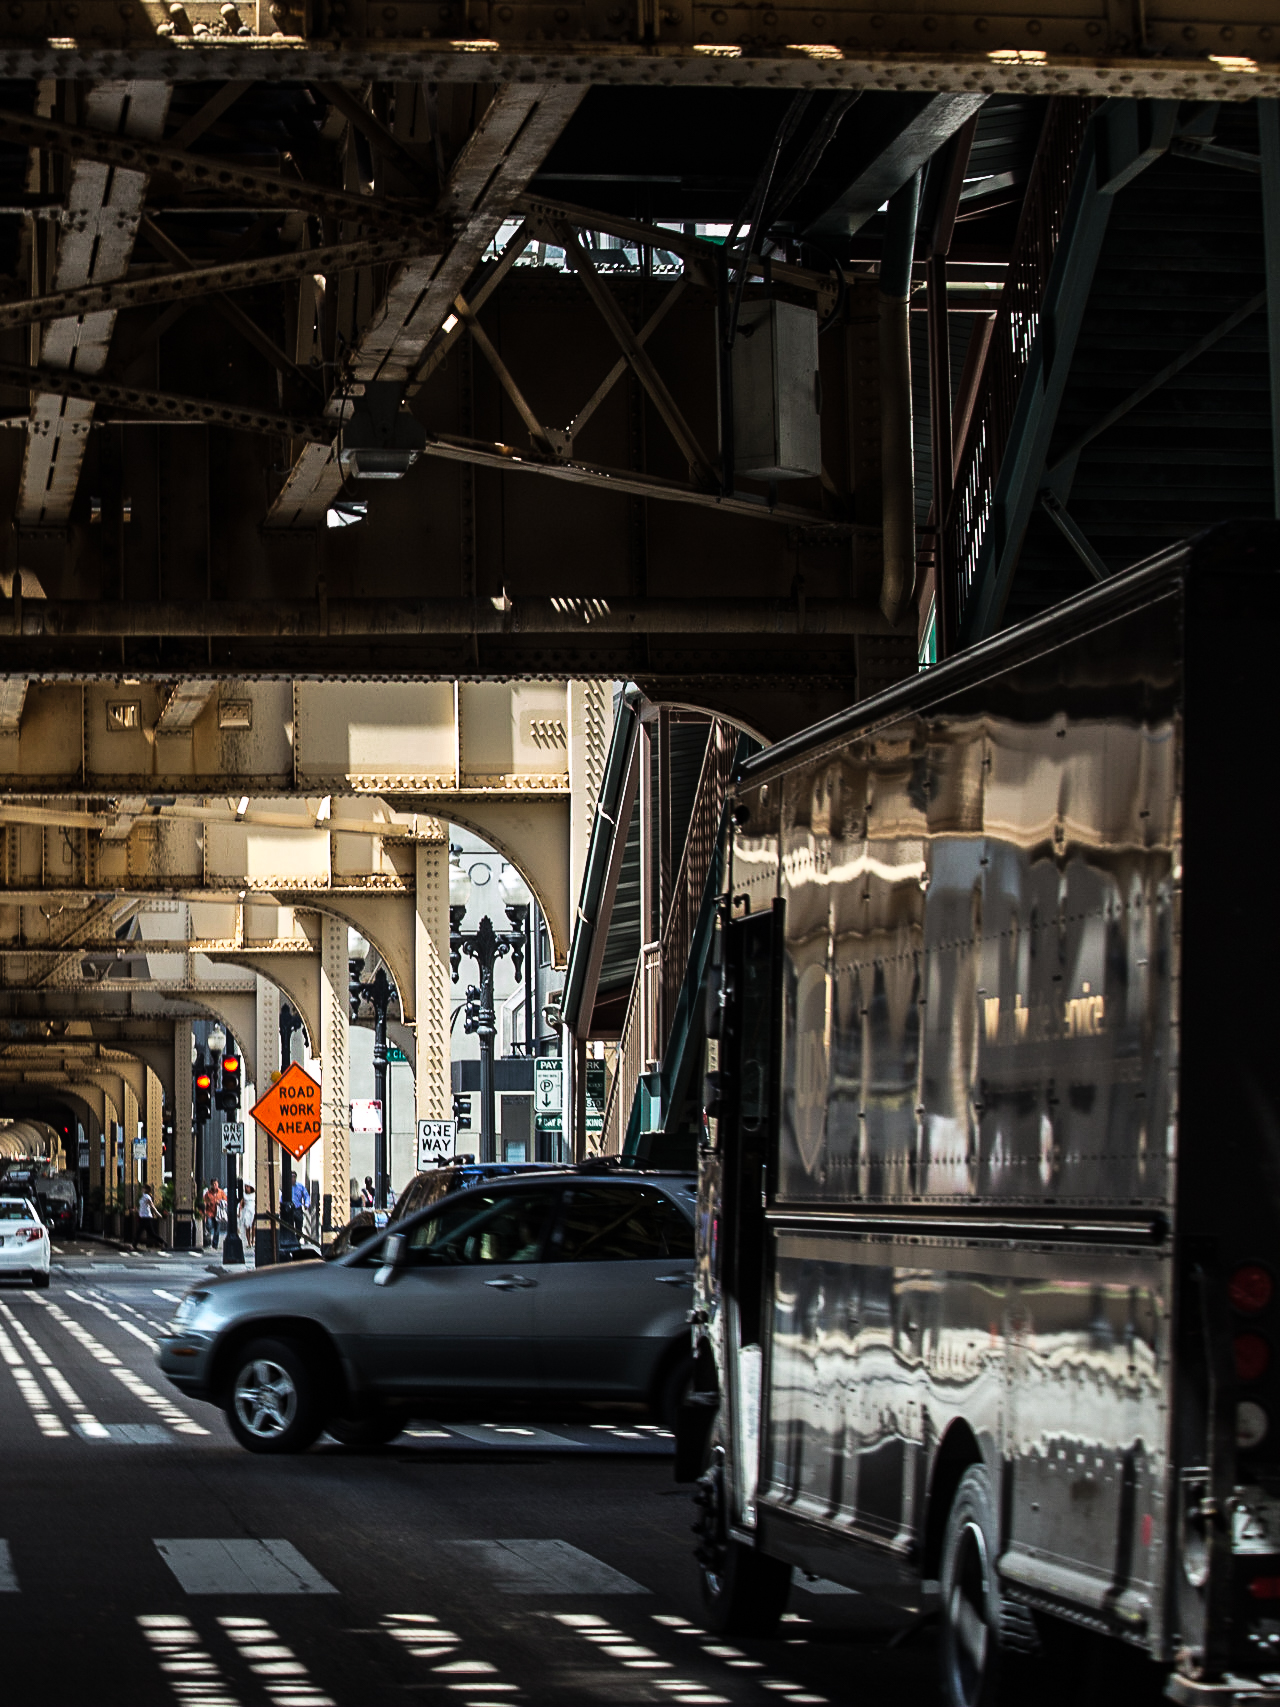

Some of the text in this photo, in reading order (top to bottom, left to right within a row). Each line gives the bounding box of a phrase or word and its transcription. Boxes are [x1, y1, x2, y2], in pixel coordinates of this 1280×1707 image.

[540, 1061, 558, 1069] PAY
[279, 1086, 315, 1098] ROAD
[279, 1104, 315, 1116] WORK
[223, 1124, 241, 1132] ONE
[276, 1121, 321, 1134] AHEAD
[423, 1124, 452, 1137] ONE
[223, 1133, 242, 1141] WAY
[422, 1138, 451, 1151] WAY
